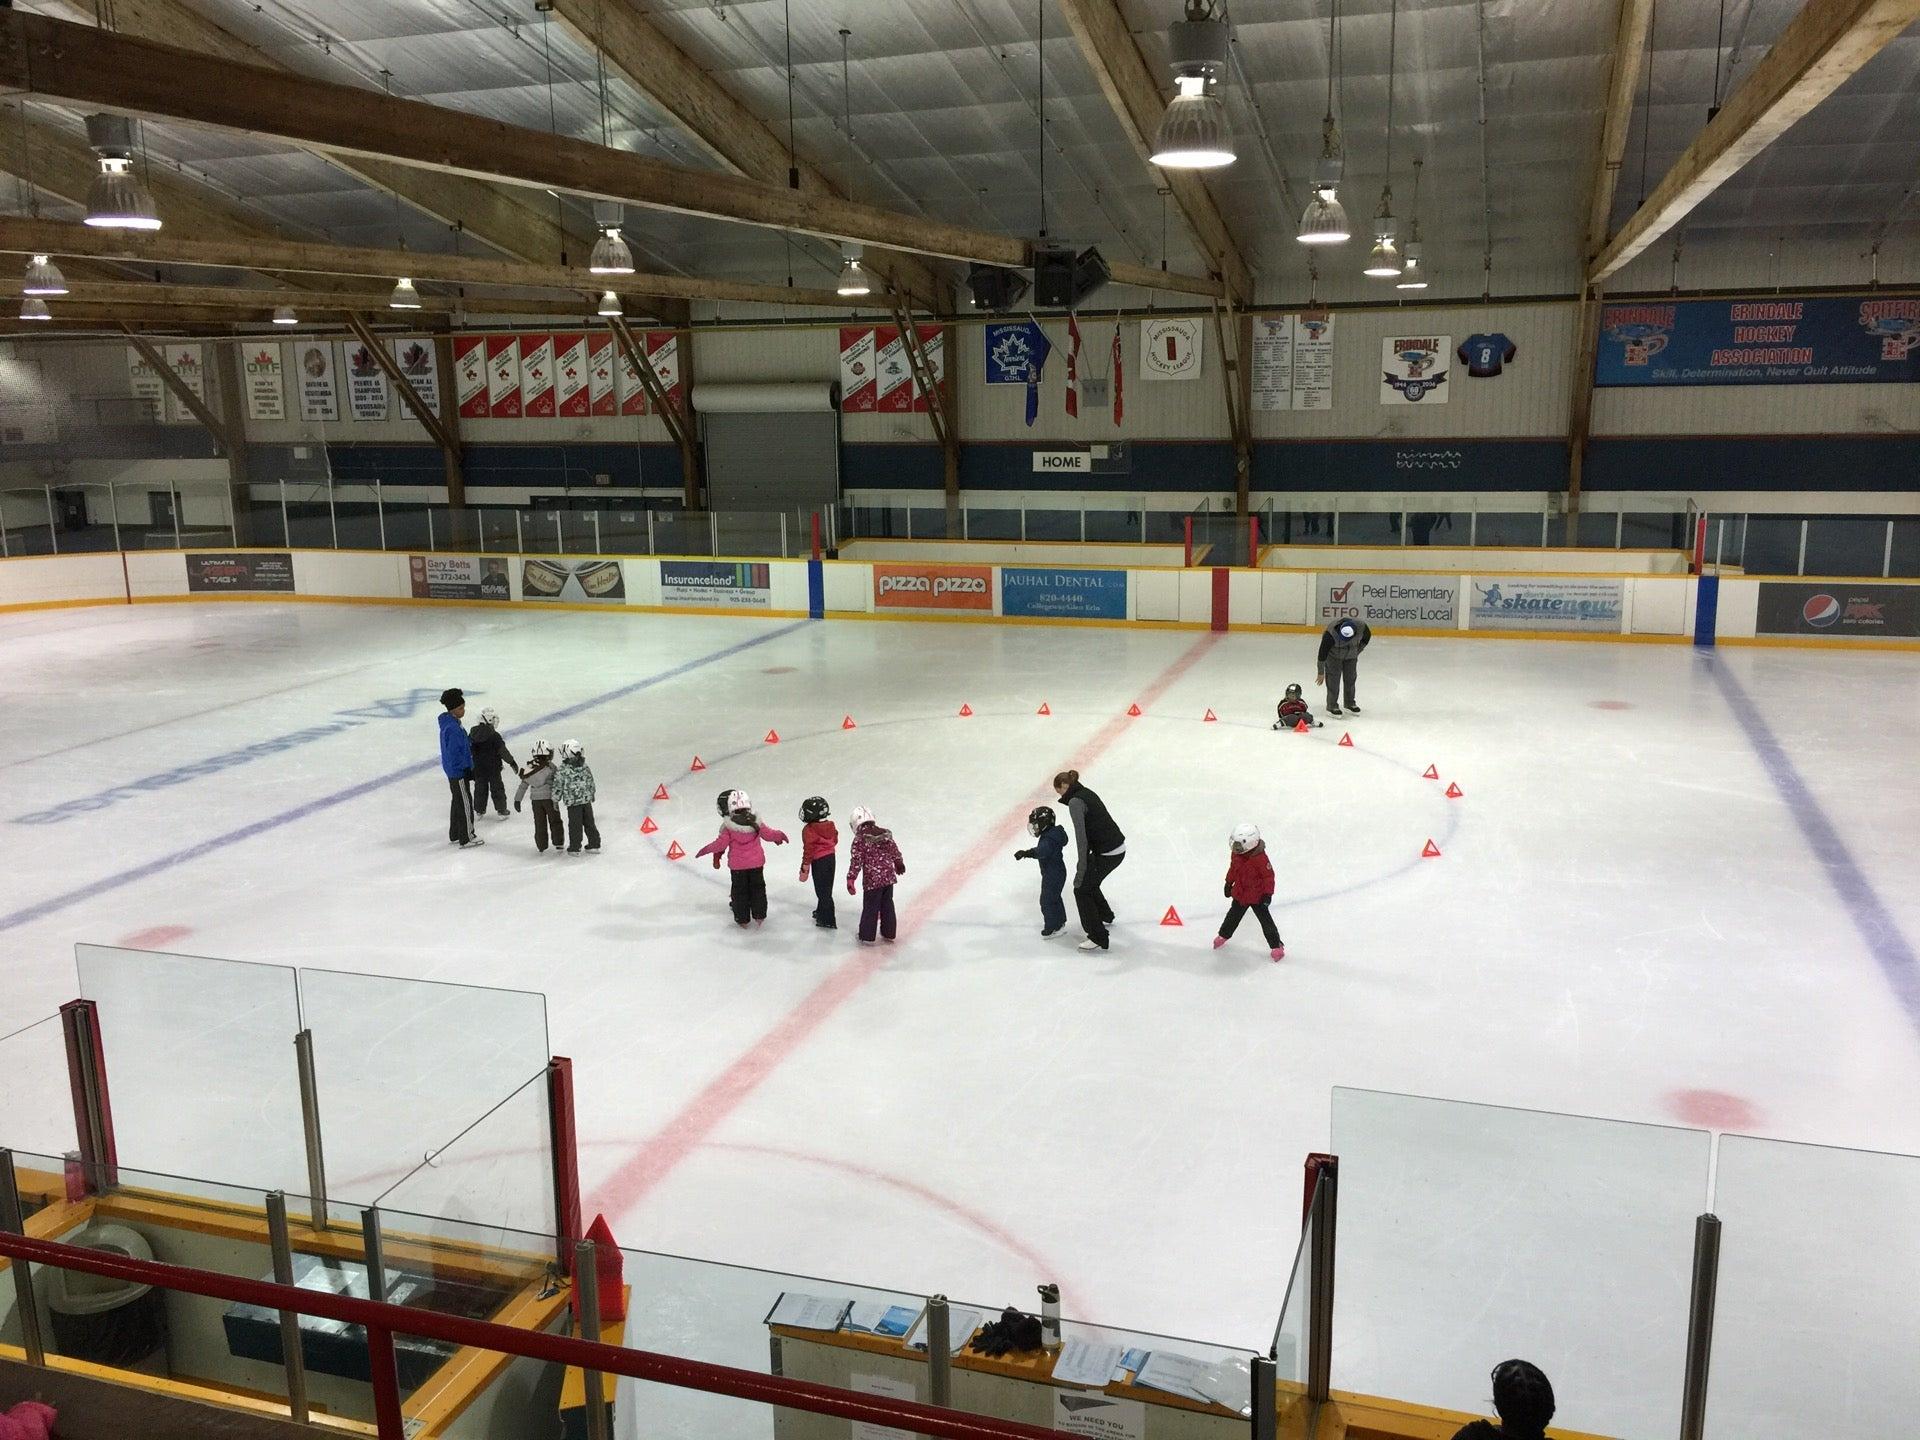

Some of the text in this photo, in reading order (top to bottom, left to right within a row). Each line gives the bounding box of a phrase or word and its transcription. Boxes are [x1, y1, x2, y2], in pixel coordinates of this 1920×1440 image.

[1731, 302, 1803, 321] ERINDALE
[993, 325, 1031, 336] MISSISSAUG
[1153, 326, 1190, 342] MISSISSAUGA
[1734, 325, 1796, 343] HOCKEY
[1151, 351, 1192, 370] HOCKEY LEAGUE
[1711, 347, 1813, 366] ASSOCIATION
[1767, 367, 1800, 377] Never
[1803, 366, 1828, 377] Quit
[1830, 365, 1876, 376] Attitude
[1042, 456, 1081, 468] HOME
[427, 559, 447, 570] Gary
[209, 576, 231, 584] TAG
[664, 574, 732, 586] Insuranceland
[879, 575, 987, 597] pizza pizza
[1004, 573, 1051, 587] JAUHAL
[1055, 575, 1104, 588] DENTAL
[1362, 584, 1454, 603] Peel Elementary
[1322, 606, 1359, 618] ETFO
[1364, 605, 1453, 621] Teachers' Local
[1084, 1416, 1105, 1426] NEED
[1107, 1420, 1124, 1430] YOU
